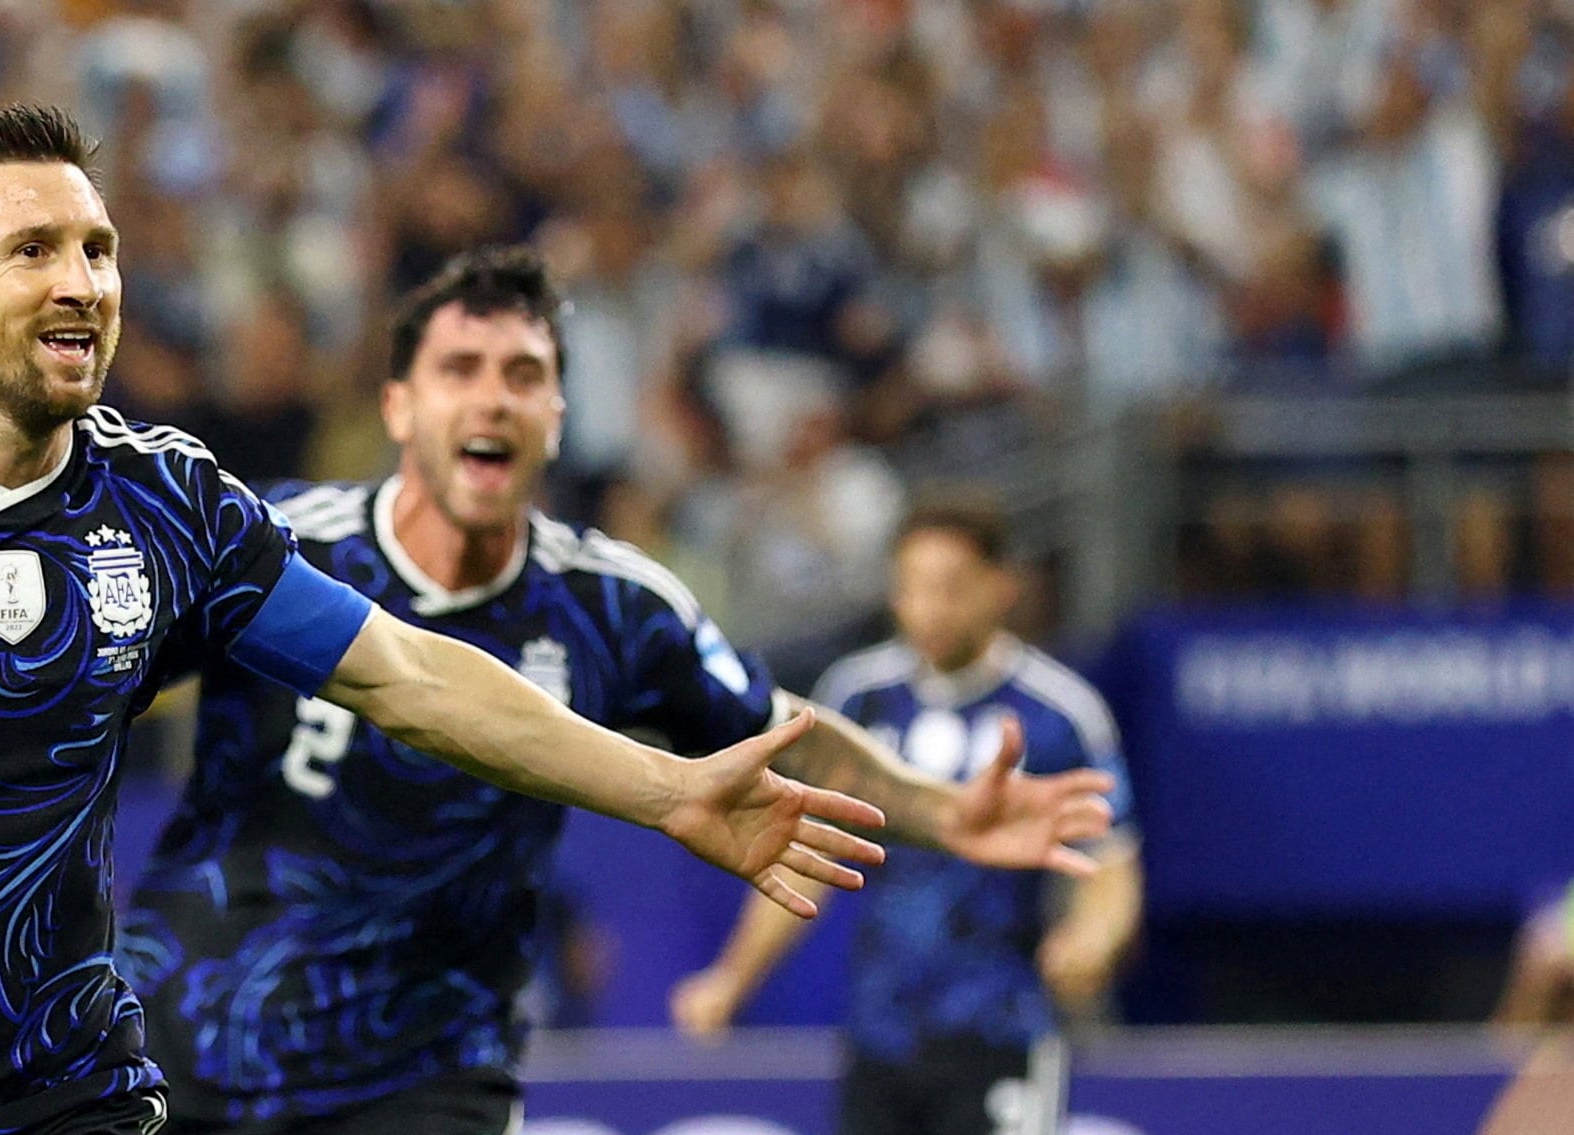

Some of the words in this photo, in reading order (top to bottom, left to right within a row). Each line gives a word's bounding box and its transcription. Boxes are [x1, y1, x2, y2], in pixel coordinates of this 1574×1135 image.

[105, 572, 138, 610] AFA
[0, 608, 28, 619] FIFA
[282, 695, 355, 798] 2
